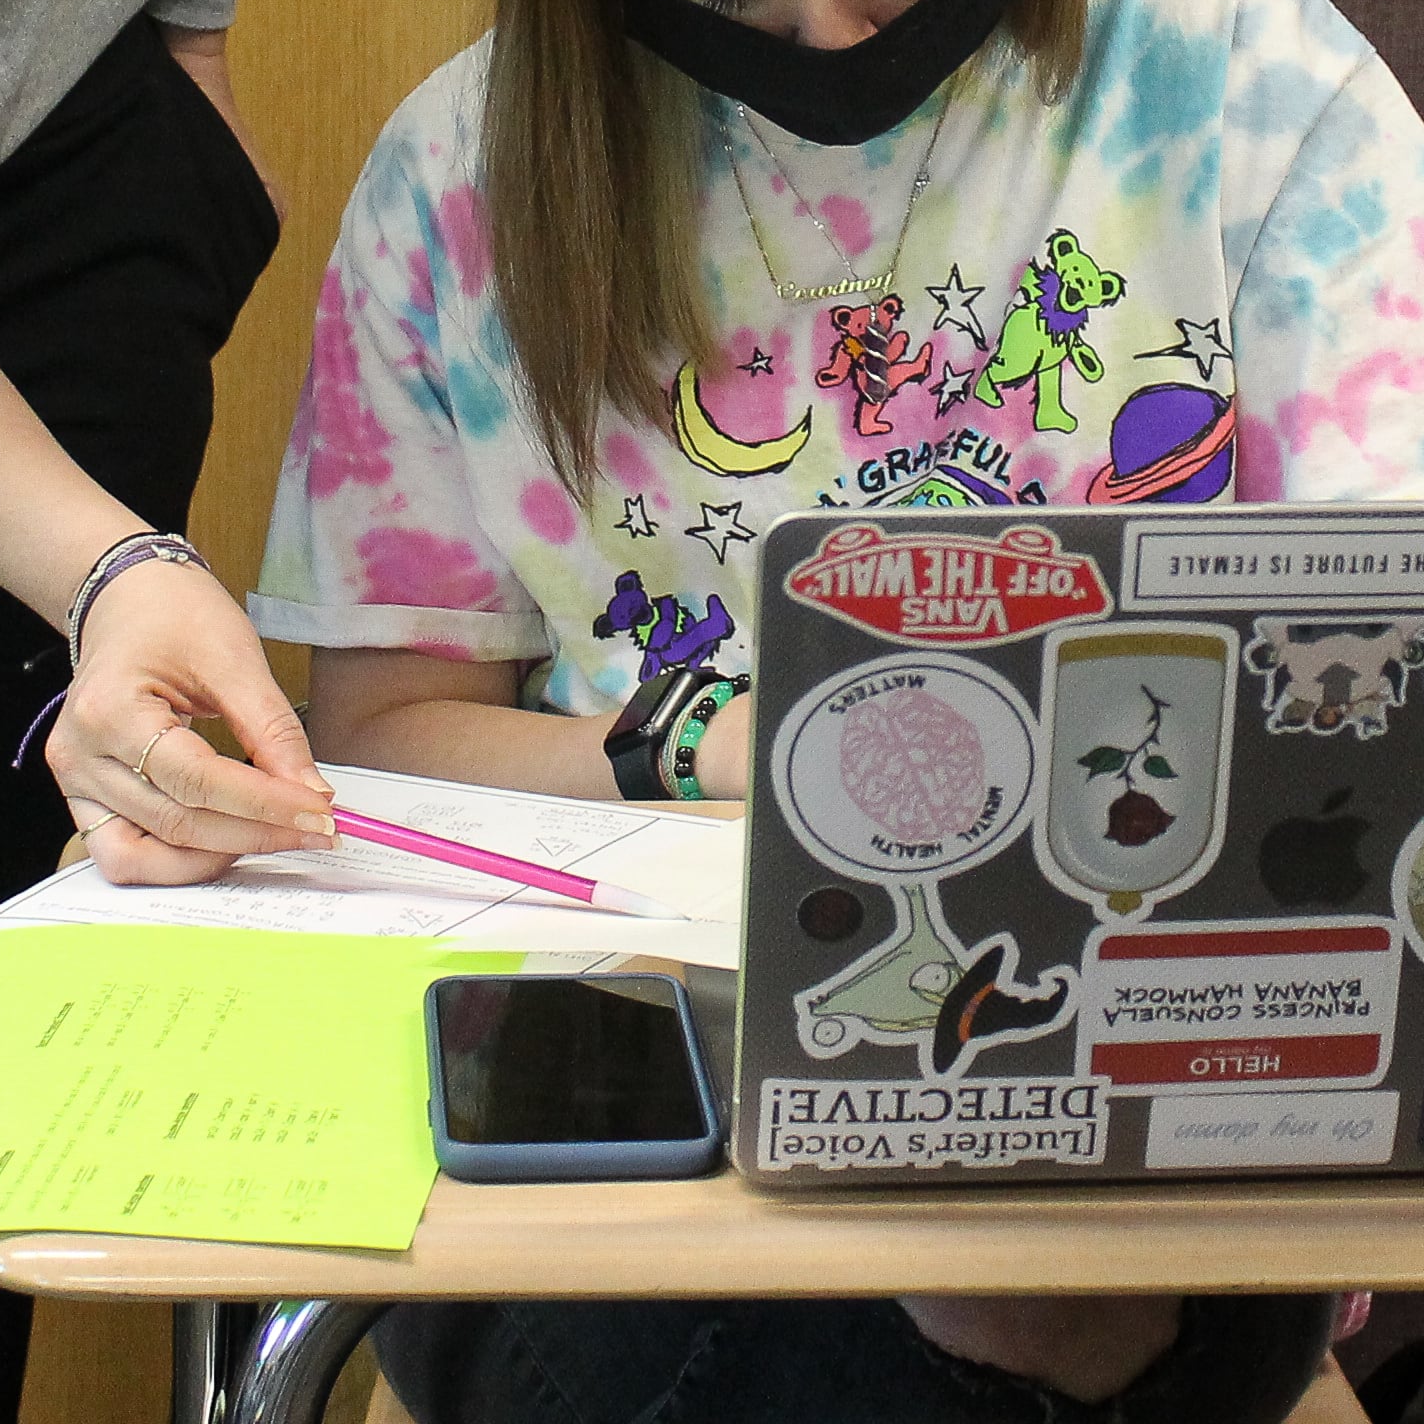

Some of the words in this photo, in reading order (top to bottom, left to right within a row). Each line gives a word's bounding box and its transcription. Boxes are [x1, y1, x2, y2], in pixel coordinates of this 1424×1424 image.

[918, 547, 1001, 598] THE
[1168, 555, 1259, 577] FEMALE
[1270, 555, 1292, 575] IS
[1303, 554, 1389, 575] FUTURE
[900, 597, 1010, 634] VANS
[827, 674, 927, 716] MATTERS
[956, 786, 1004, 844] MENTAL
[869, 834, 944, 861] HEALTH
[1113, 983, 1243, 1006] HAMMOCK
[1253, 978, 1362, 1002] BANANA
[1102, 1004, 1241, 1028] CONSUELA
[1252, 999, 1371, 1020] PRINCESS
[1189, 1055, 1281, 1076] HELLO
[770, 1085, 1099, 1125] DETECTIVE!
[768, 1126, 894, 1162] Voice]
[908, 1122, 1097, 1161] [Lucifer's
